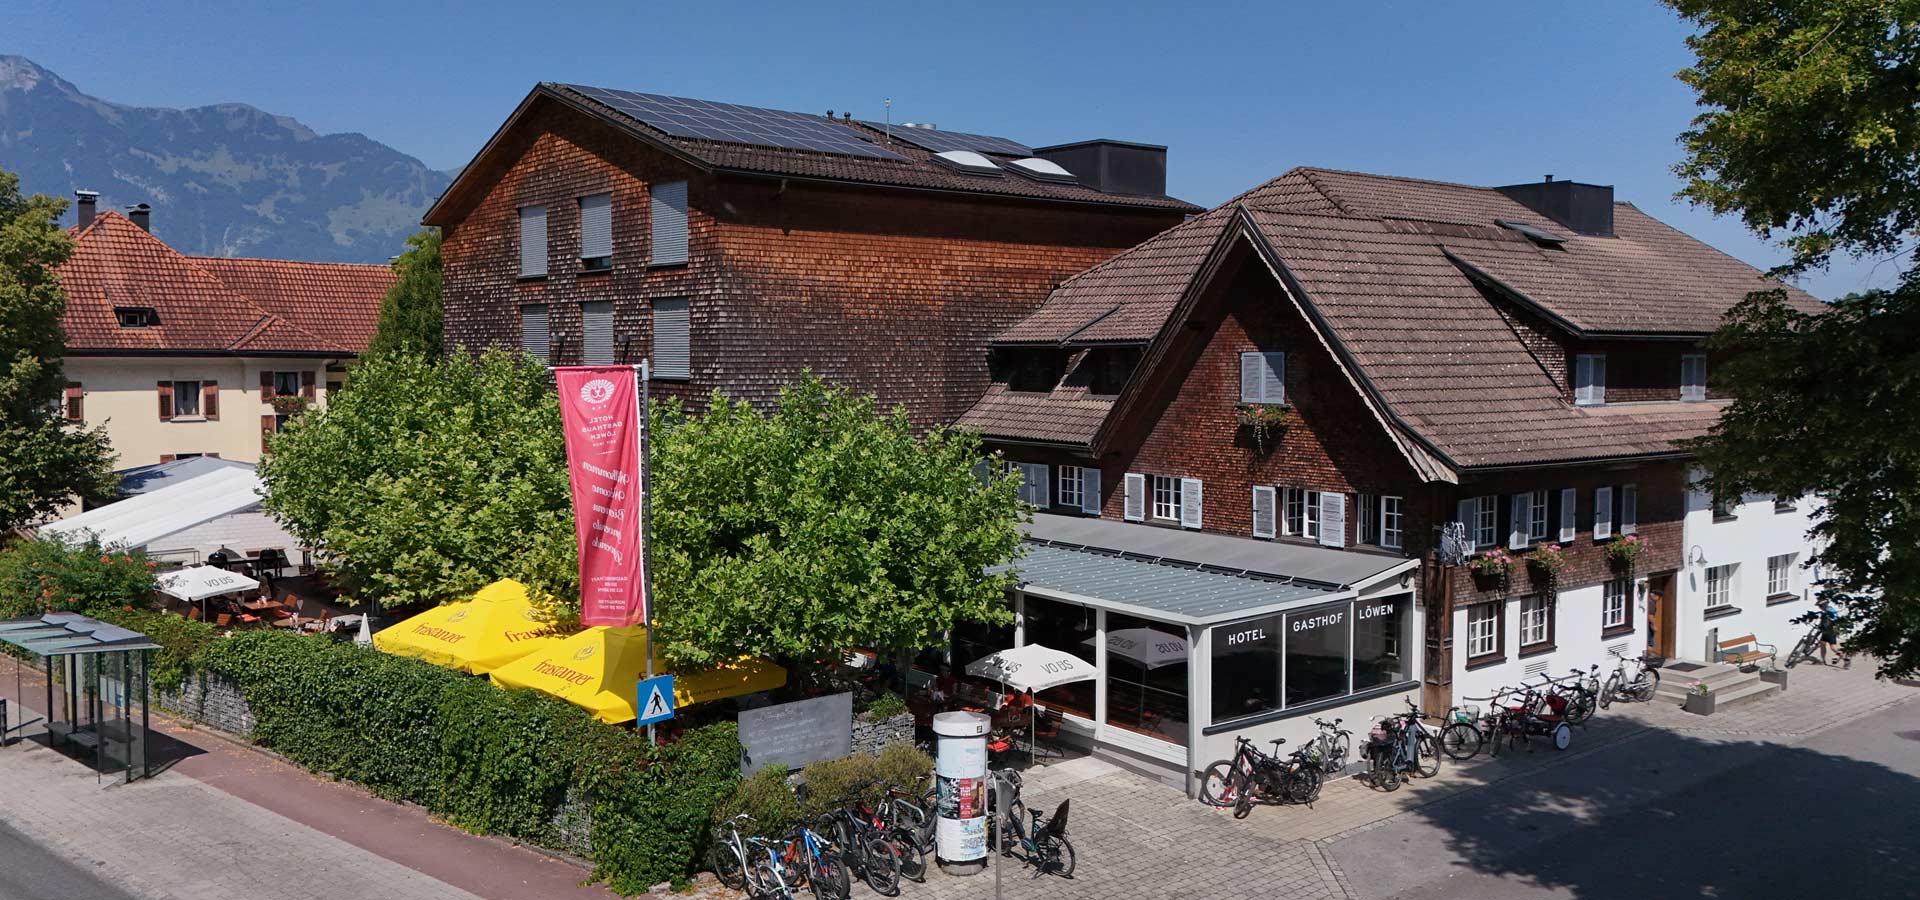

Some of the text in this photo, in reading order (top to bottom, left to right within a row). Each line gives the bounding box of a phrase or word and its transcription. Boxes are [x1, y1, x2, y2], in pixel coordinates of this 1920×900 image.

[411, 622, 466, 644] frastanzer
[1228, 603, 1394, 646] HOTEL GASTHOF LÖWEN
[533, 658, 595, 686] frastanzer
[1039, 662, 1059, 674] VO
